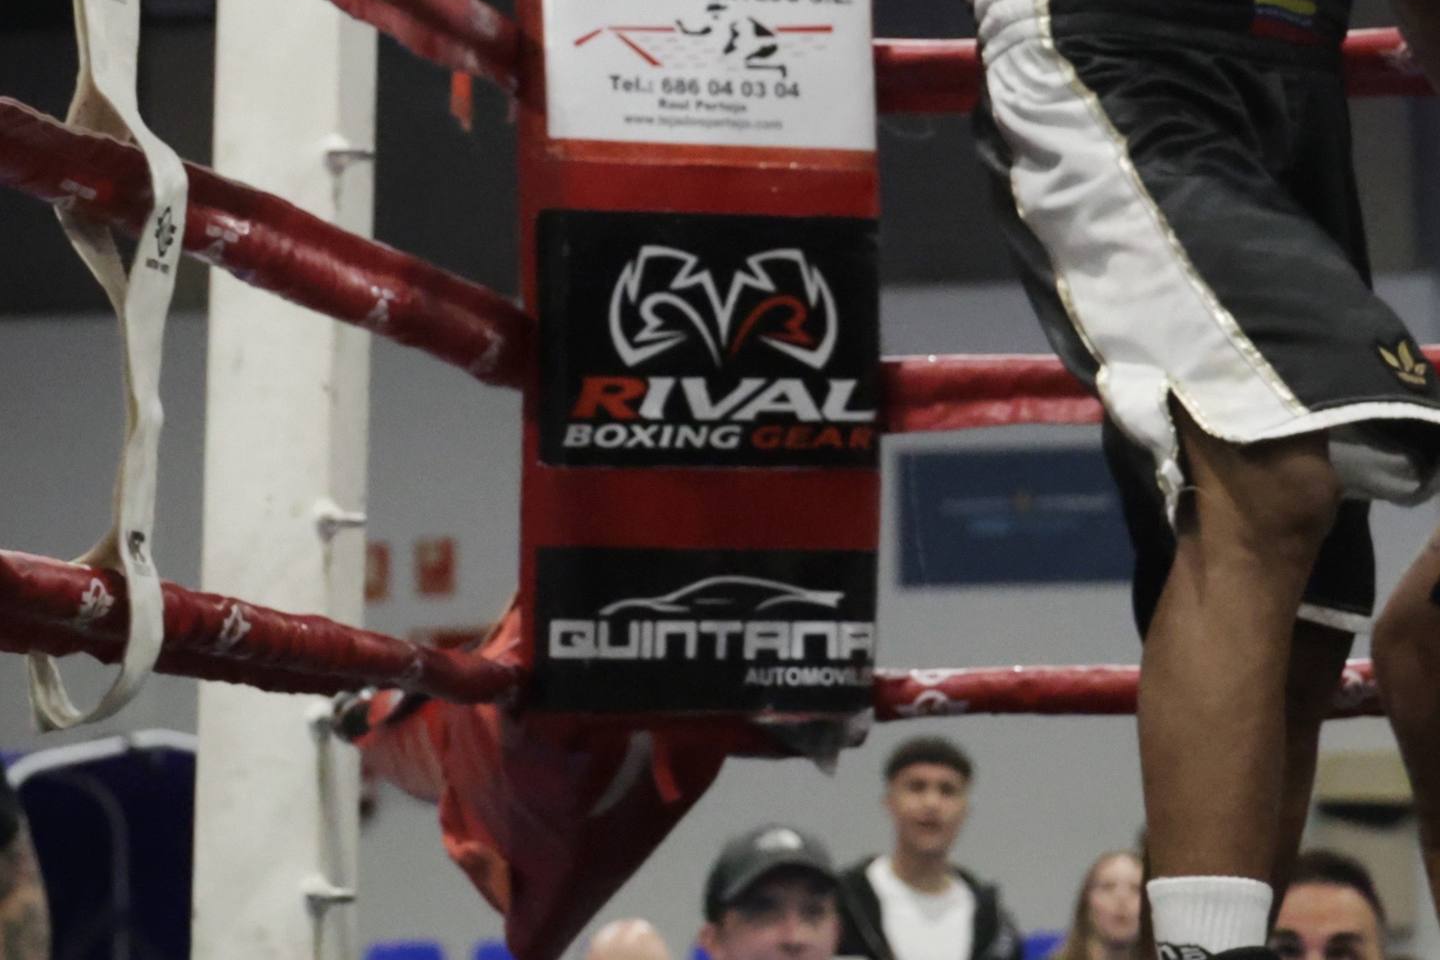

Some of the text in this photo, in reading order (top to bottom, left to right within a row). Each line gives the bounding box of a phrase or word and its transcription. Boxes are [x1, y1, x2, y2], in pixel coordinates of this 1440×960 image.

[661, 77, 699, 95] 686
[707, 80, 733, 96] 04
[741, 81, 766, 98] 03
[774, 82, 800, 99] 04
[570, 376, 876, 422] RIVAL
[563, 423, 874, 450] BOXING GEAR
[549, 619, 875, 659] QUINTANA
